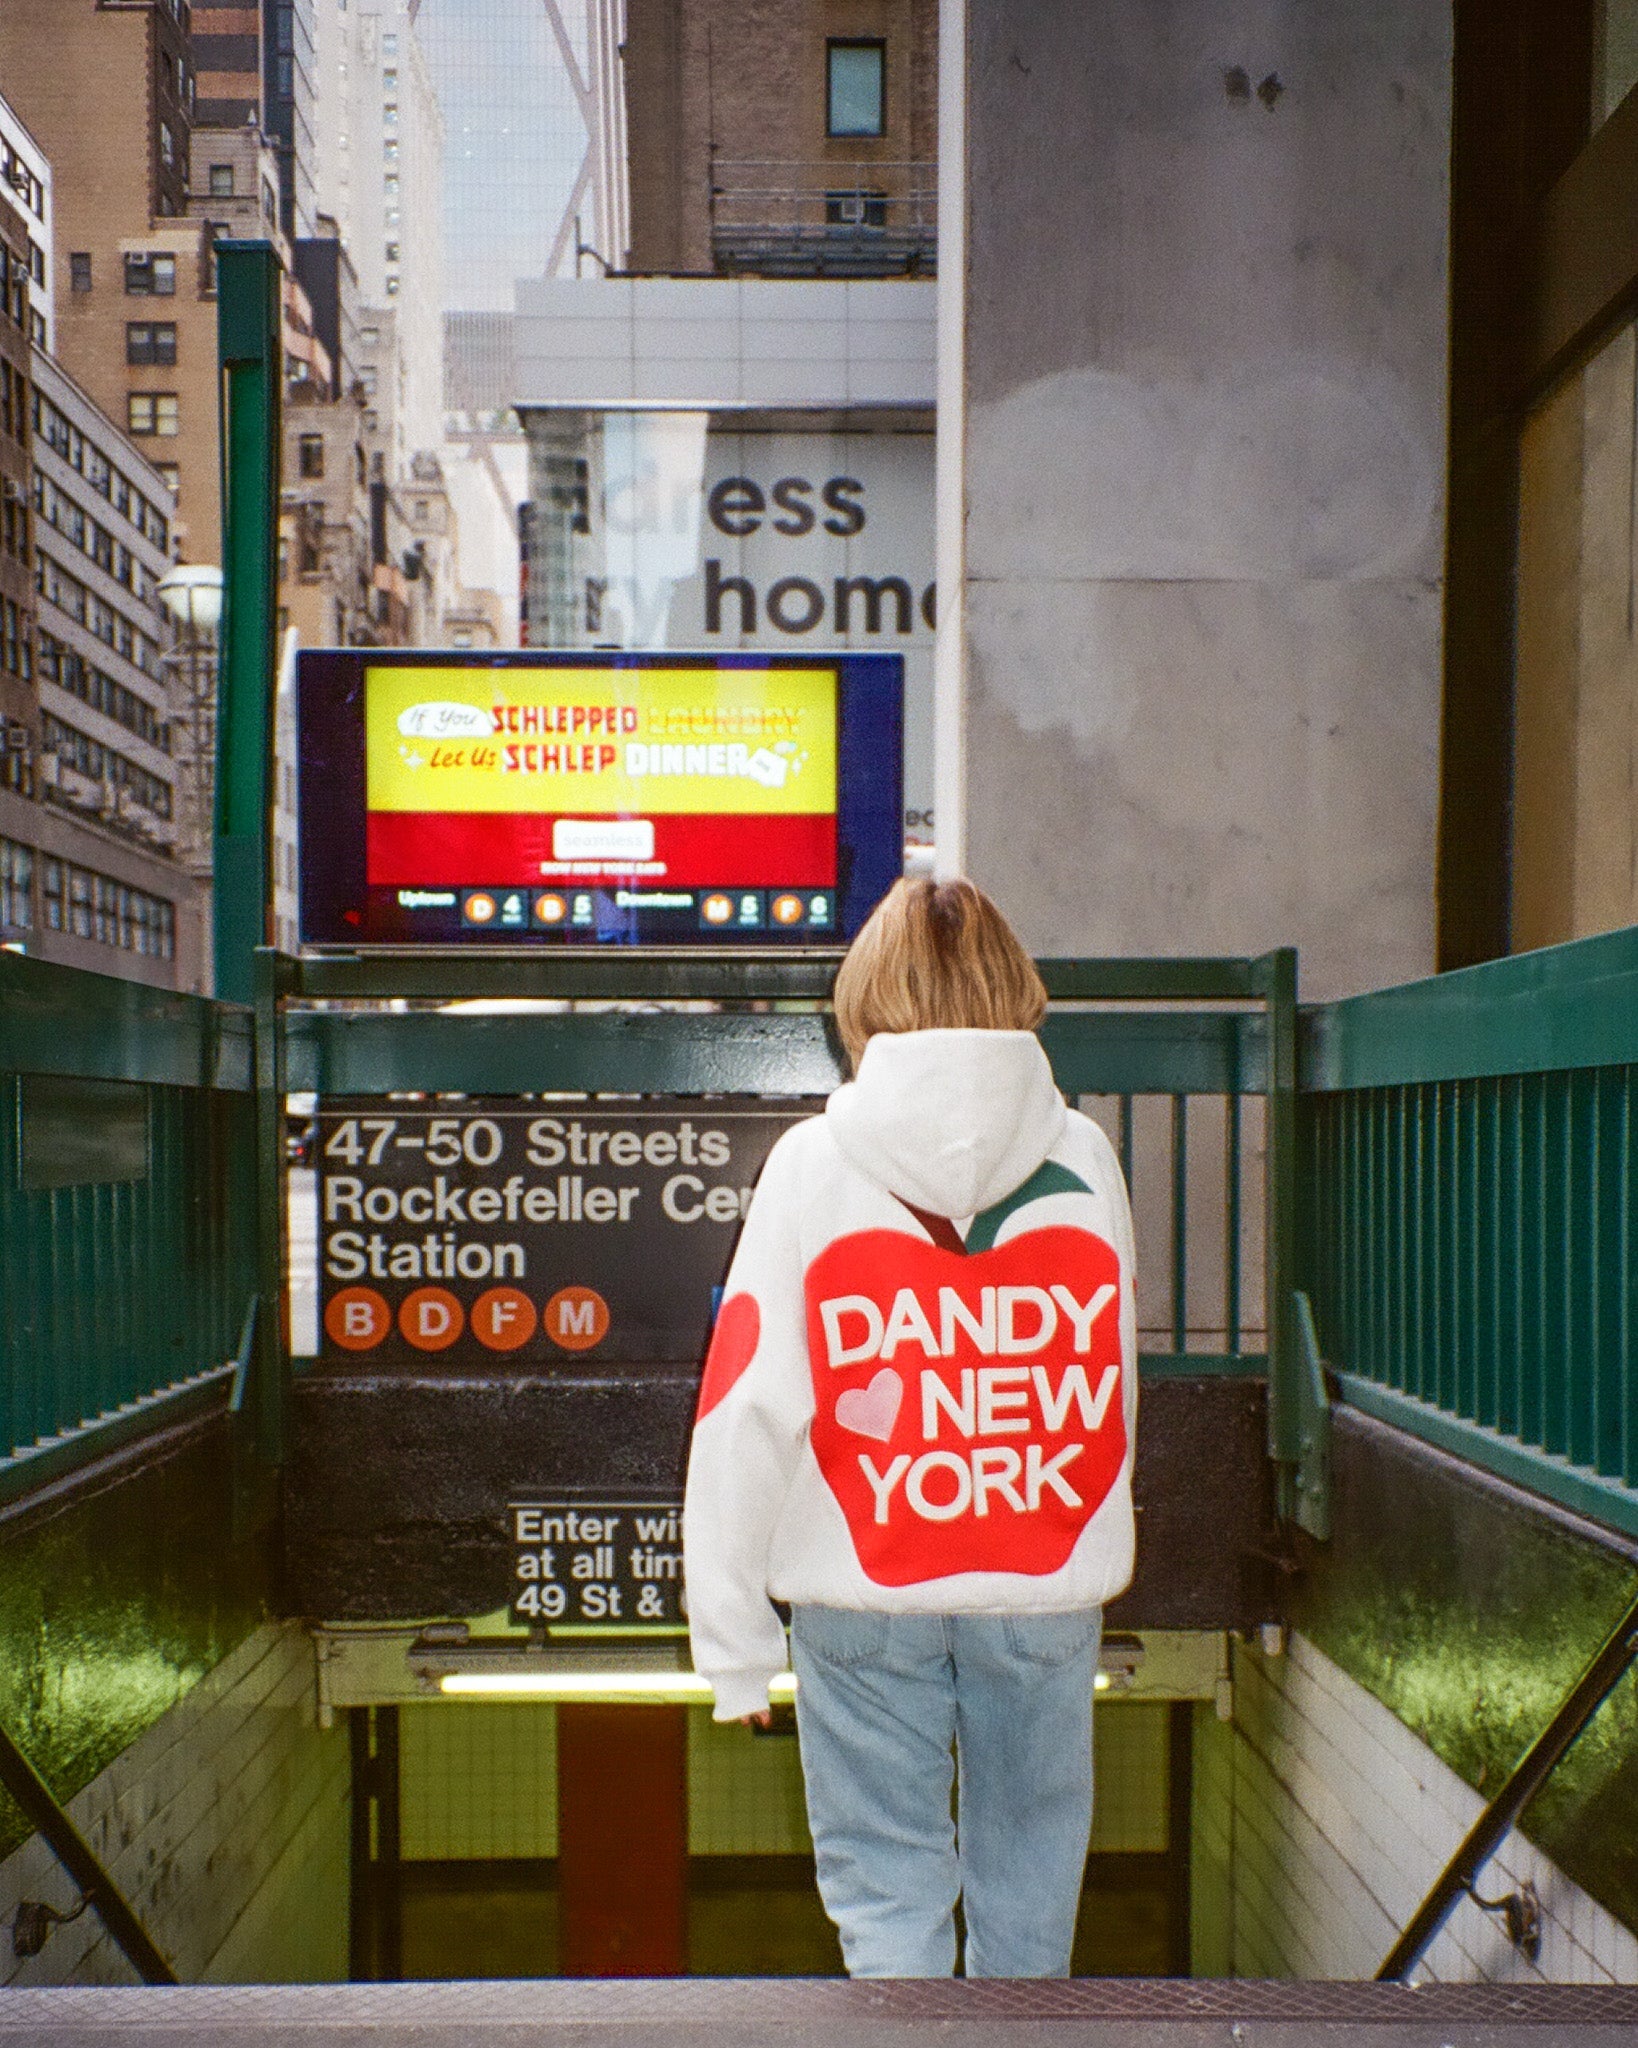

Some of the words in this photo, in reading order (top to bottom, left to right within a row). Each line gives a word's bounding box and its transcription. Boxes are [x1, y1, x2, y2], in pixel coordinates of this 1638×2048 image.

[704, 558, 938, 635] hom
[491, 705, 638, 735] SCHLEPPED
[430, 747, 464, 768] Let
[471, 747, 496, 767] Us
[502, 744, 616, 774] SCHLEP
[625, 743, 750, 777] DINNER
[398, 889, 456, 908] Uptown
[503, 894, 521, 914] 4
[573, 894, 591, 914] 5
[615, 890, 693, 908] Downtown
[707, 899, 730, 920] M
[740, 894, 758, 915] 5
[780, 899, 797, 920] F
[323, 1119, 503, 1166] 47-50
[526, 1119, 730, 1166] Streets
[324, 1175, 640, 1222] Rockefeller
[325, 1232, 525, 1279] Station
[343, 1302, 374, 1337] B
[418, 1302, 450, 1337] D
[491, 1302, 516, 1337] F
[558, 1302, 596, 1337] M
[818, 1284, 1116, 1369] DANDY
[919, 1364, 1120, 1440] NEW
[857, 1444, 1084, 1525] YORK
[515, 1510, 620, 1543] Enter
[516, 1548, 555, 1579] at
[572, 1547, 614, 1579] all
[515, 1584, 568, 1618] 49
[581, 1584, 622, 1618] St
[636, 1584, 664, 1617] &
